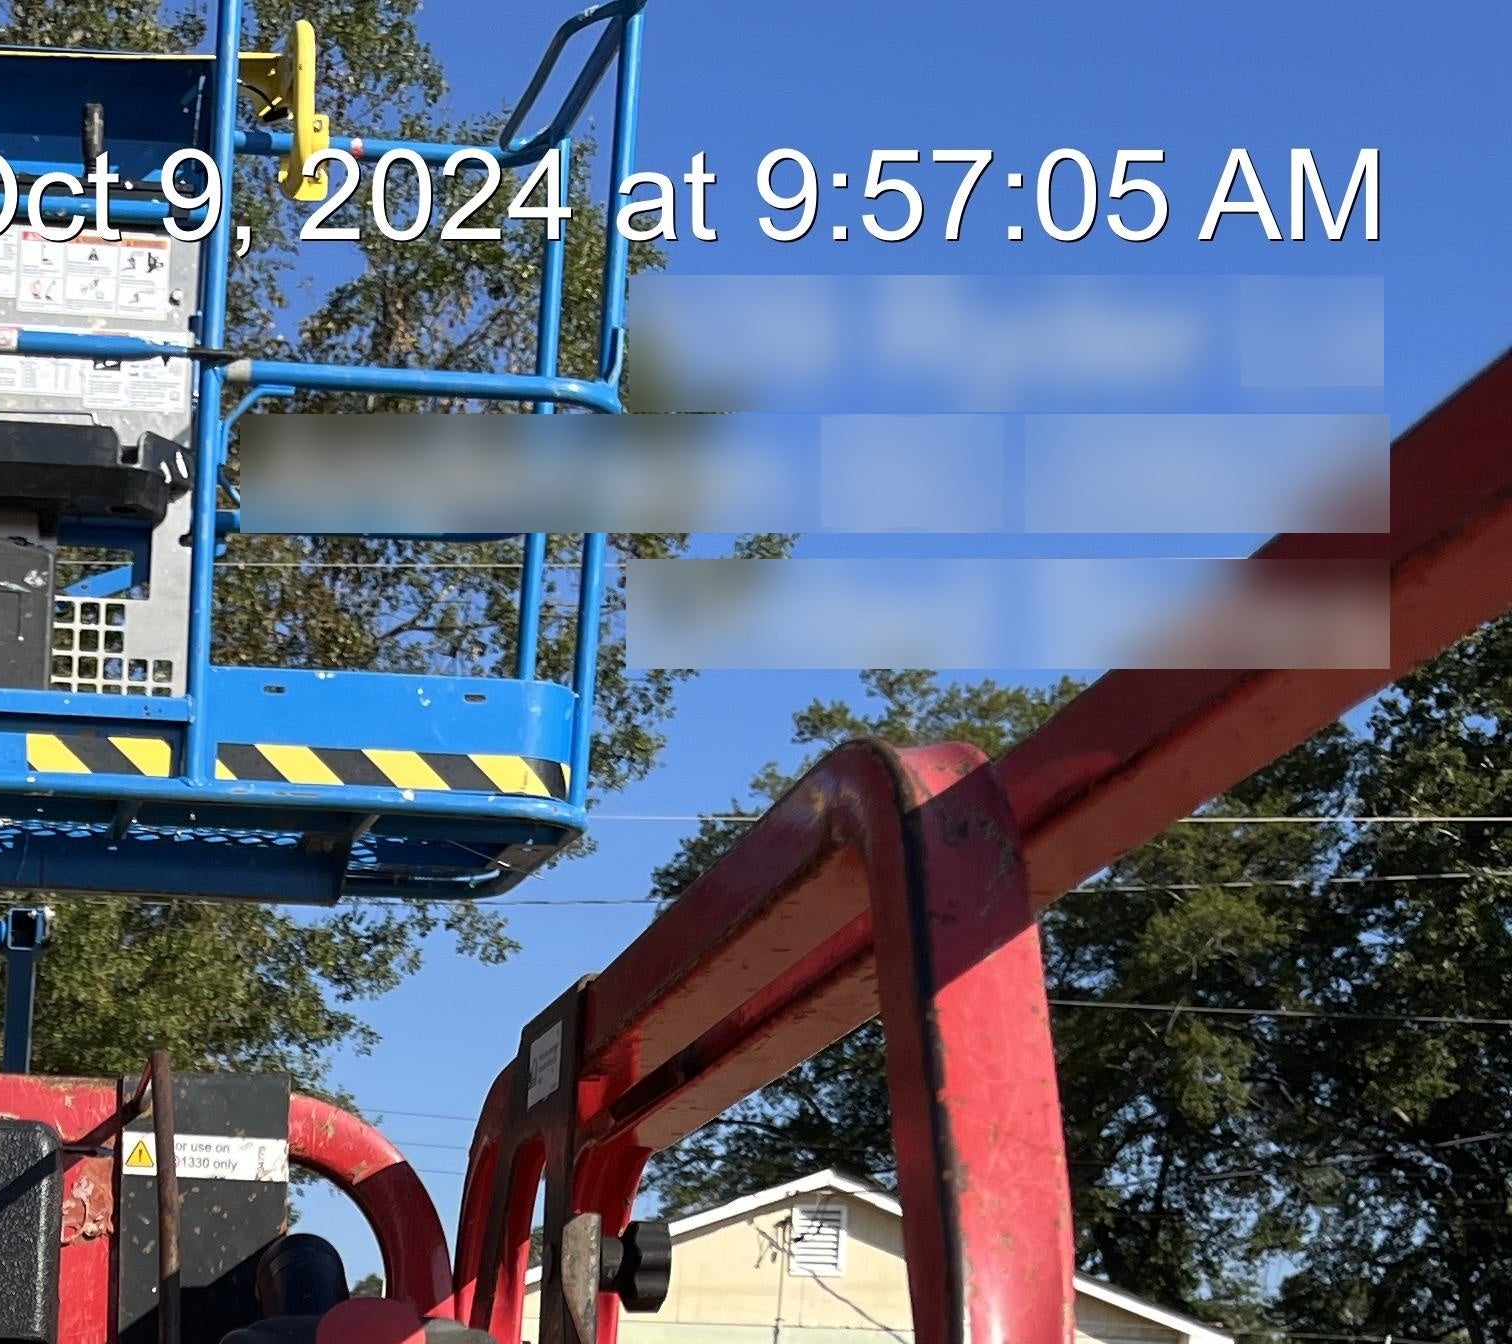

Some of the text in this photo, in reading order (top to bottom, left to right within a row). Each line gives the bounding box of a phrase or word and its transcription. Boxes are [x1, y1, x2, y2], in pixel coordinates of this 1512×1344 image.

[190, 1142, 212, 1153] use
[215, 1144, 231, 1154] on
[182, 1157, 239, 1172] 1330 only
